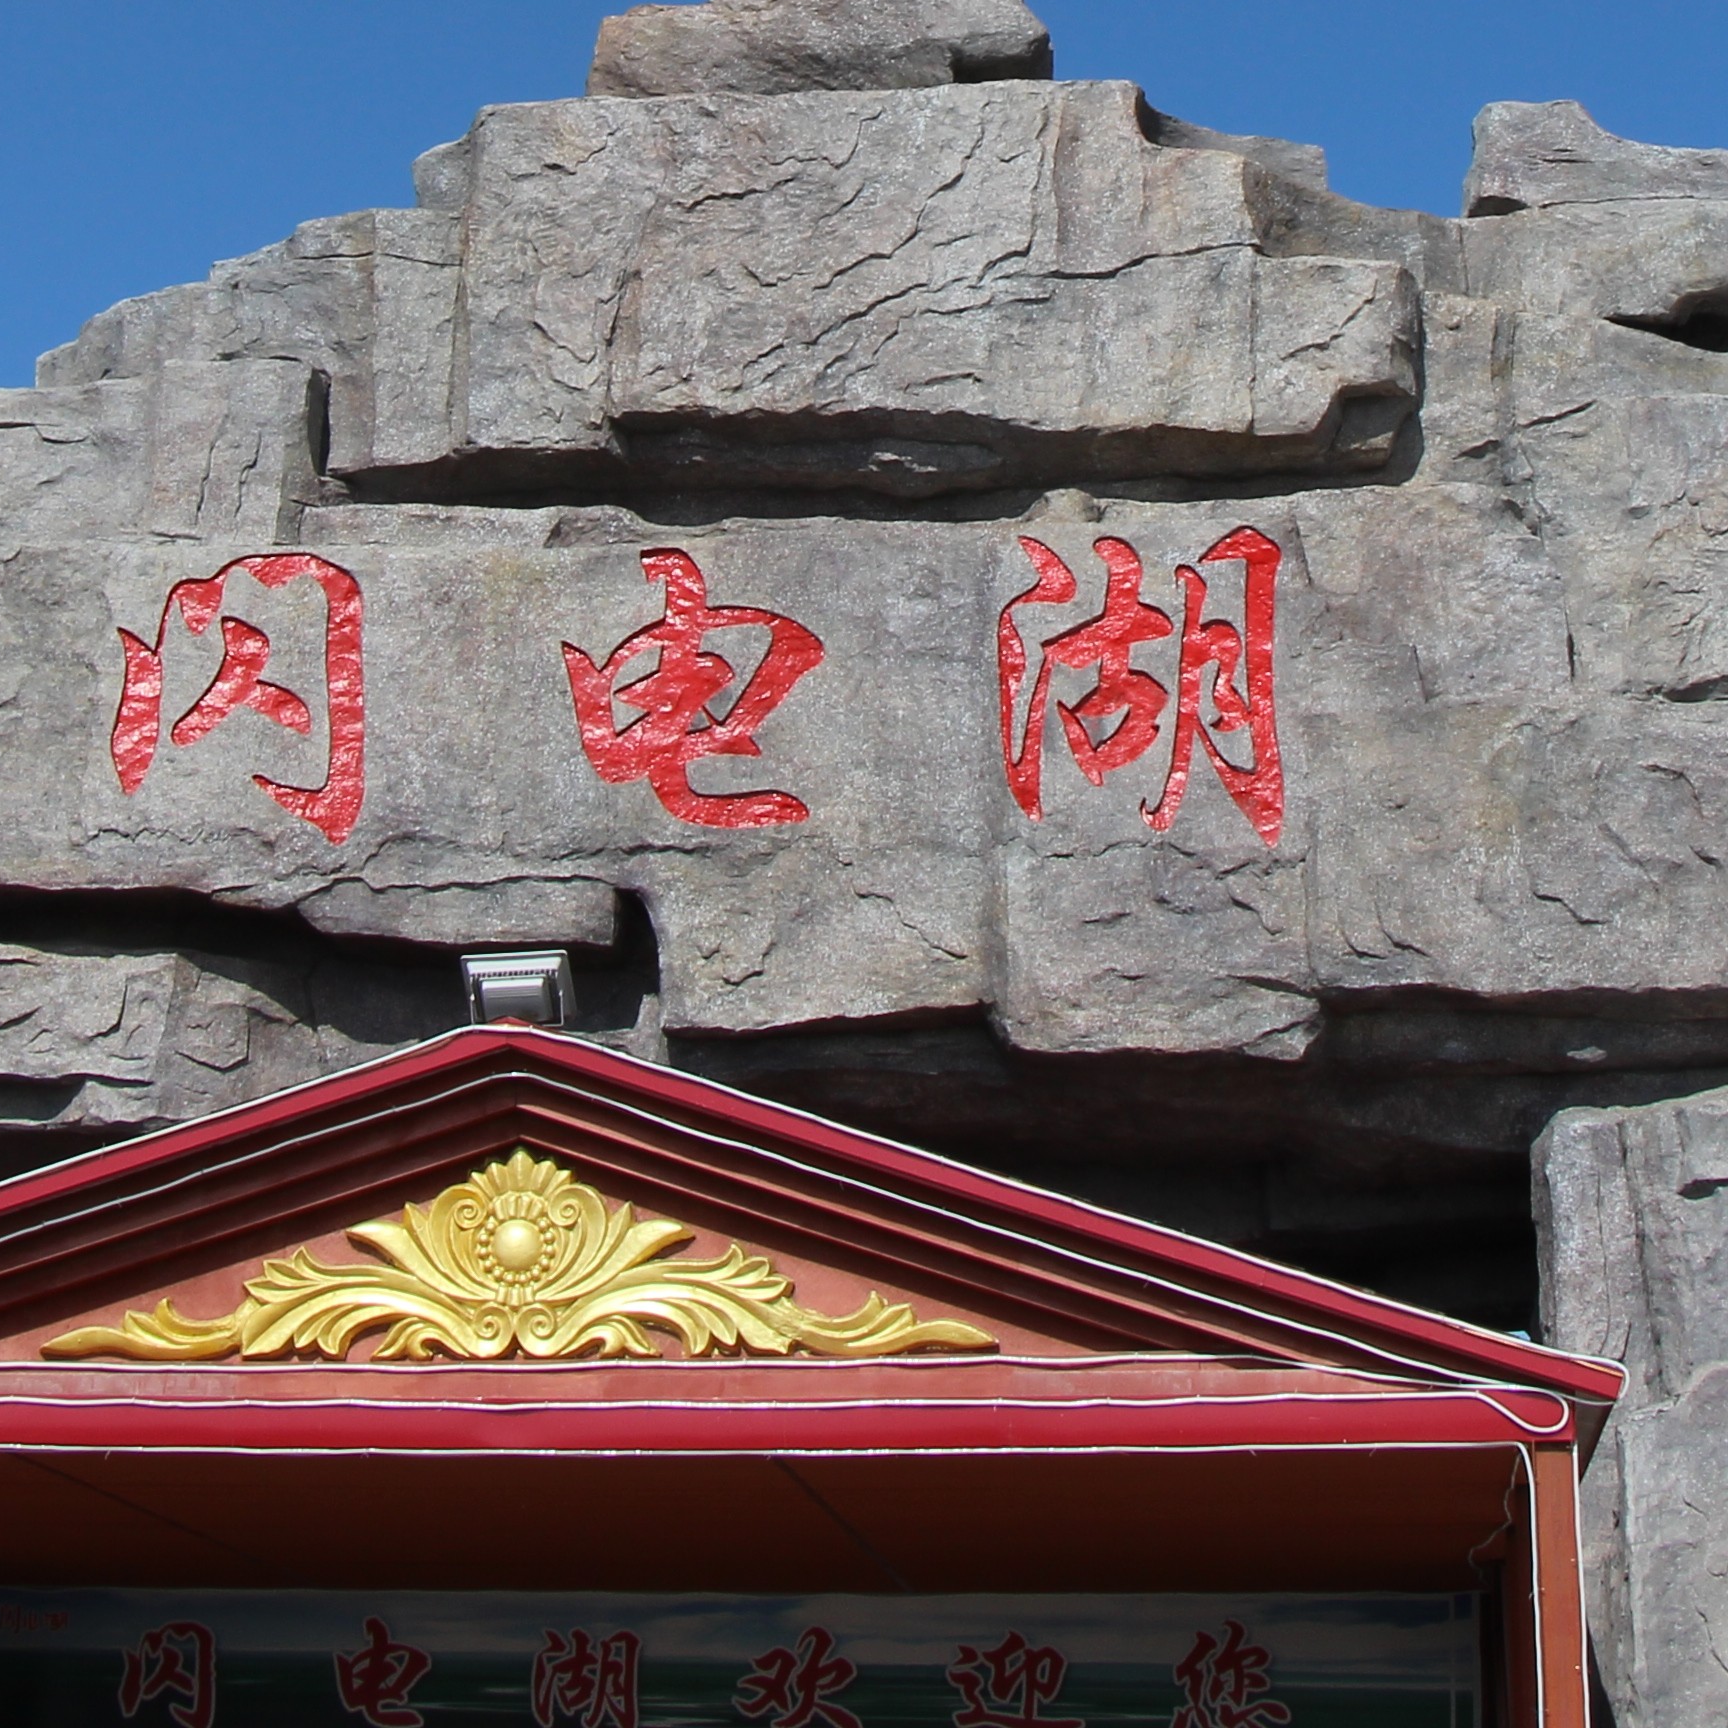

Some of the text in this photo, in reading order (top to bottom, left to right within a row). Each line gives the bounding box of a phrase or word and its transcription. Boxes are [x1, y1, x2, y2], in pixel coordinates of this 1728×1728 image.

[113, 529, 1283, 845] 闪电湖
[119, 1617, 1292, 1728] 闪电湖欢迎您
